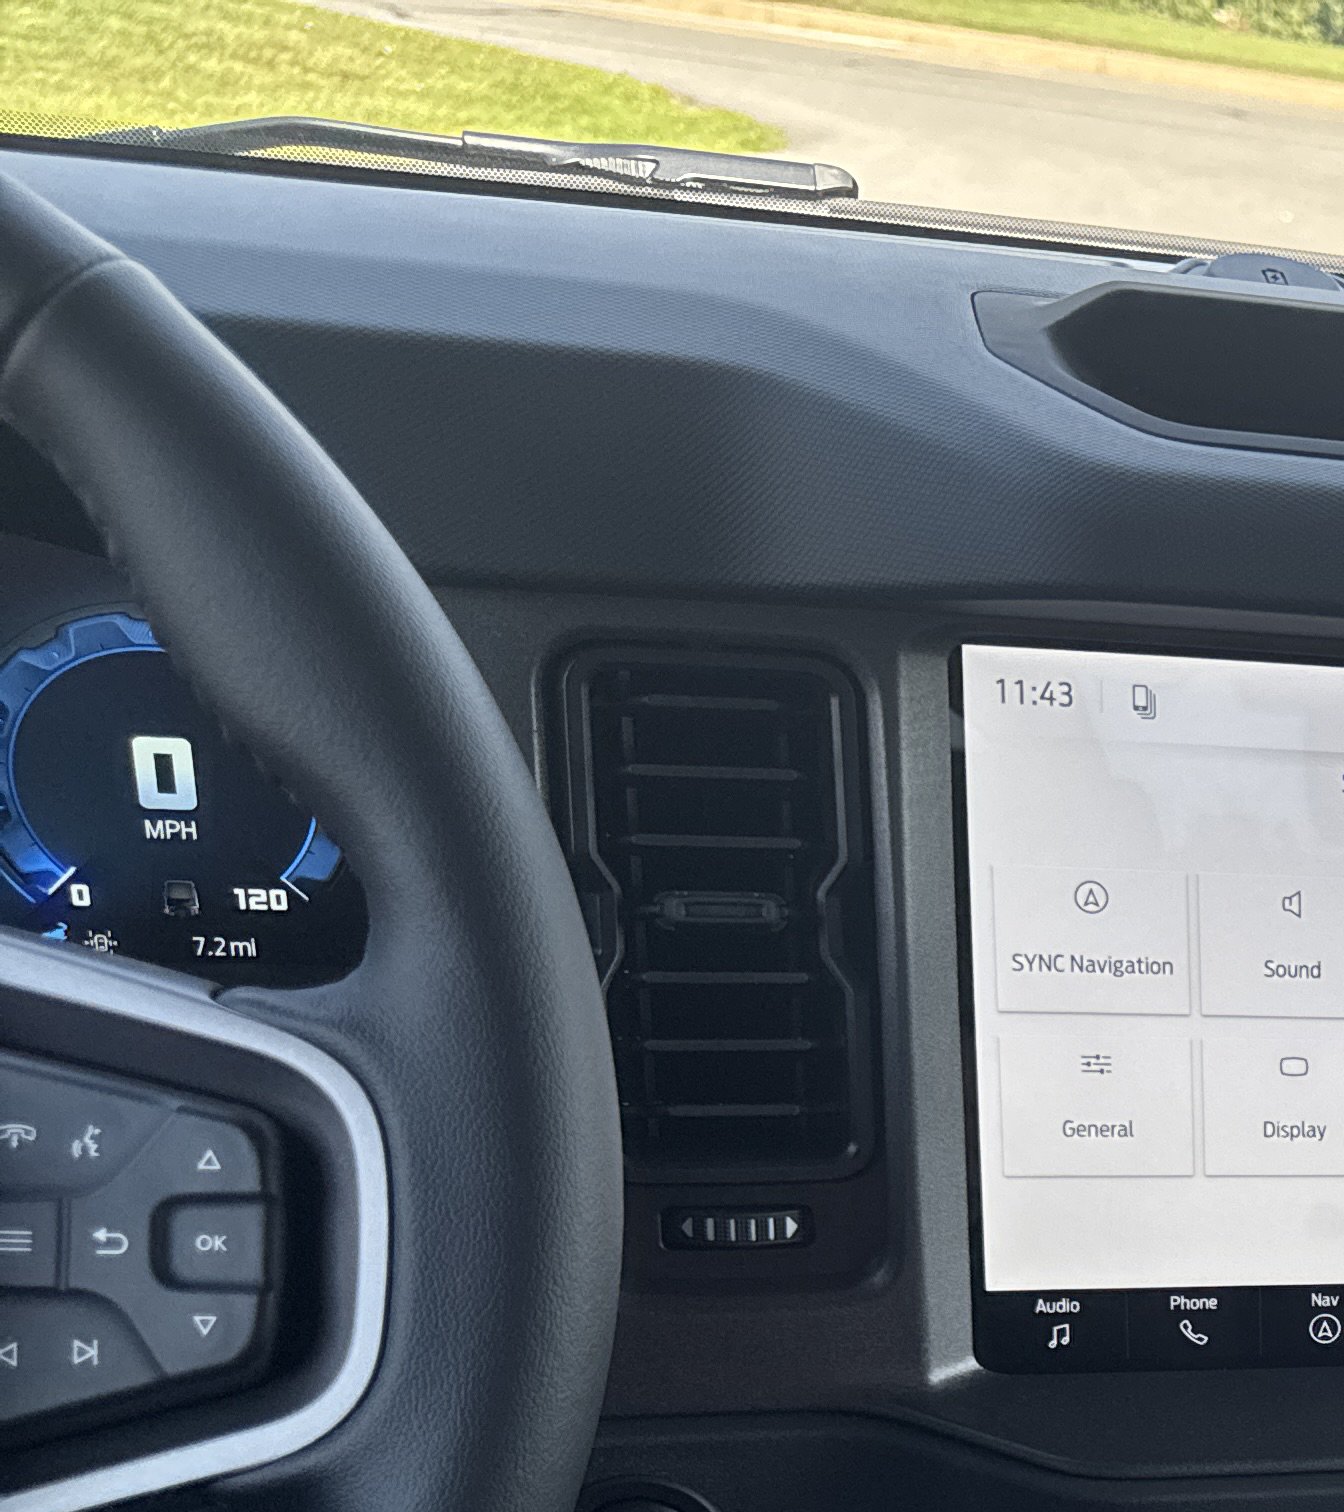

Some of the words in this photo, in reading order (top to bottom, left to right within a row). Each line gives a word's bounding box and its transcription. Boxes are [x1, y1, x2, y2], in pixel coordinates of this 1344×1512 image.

[995, 677, 1075, 708] 11:43
[131, 736, 198, 811] 0
[144, 819, 198, 840] MPH
[70, 884, 91, 906] 0
[233, 888, 288, 911] 120
[192, 936, 227, 957] 7.2
[230, 936, 257, 957] mi
[1011, 953, 1065, 974] SYNC
[1070, 953, 1174, 978] Navigation
[1263, 959, 1321, 980] Sound
[1062, 1119, 1134, 1138] General
[1263, 1121, 1327, 1142] Display
[195, 1234, 227, 1251] OK
[1035, 1297, 1080, 1315] Audio
[1169, 1293, 1218, 1311] Phone
[1310, 1291, 1339, 1307] Nav
